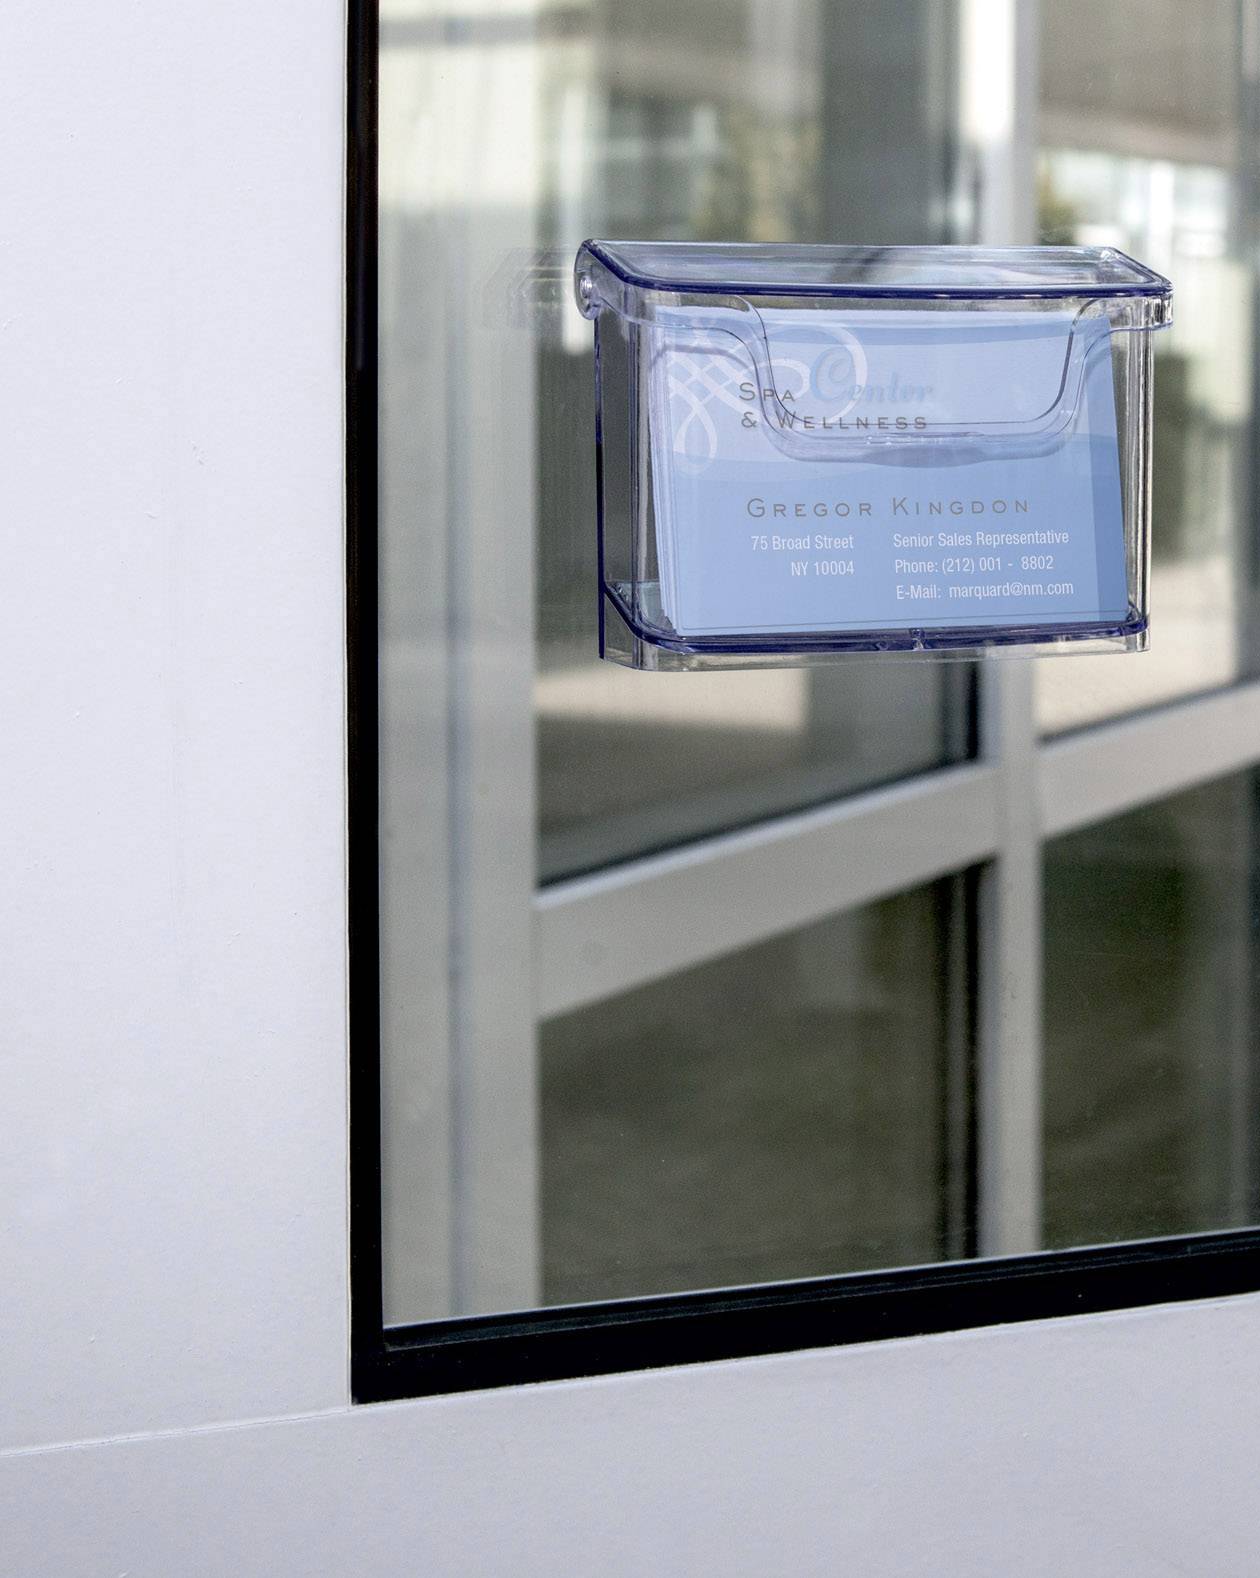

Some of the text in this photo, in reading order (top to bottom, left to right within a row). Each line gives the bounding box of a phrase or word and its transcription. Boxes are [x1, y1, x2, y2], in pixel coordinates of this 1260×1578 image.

[810, 346, 934, 404] Center
[740, 411, 759, 429] &
[751, 534, 855, 551] 75 Broad Street
[893, 529, 1070, 548] Senior Sales Representative
[791, 560, 855, 577] NY 10004
[895, 558, 938, 574] Phone:
[941, 556, 976, 575] (212)
[979, 556, 1002, 572] 001
[1020, 555, 1054, 571] 8802
[896, 581, 1074, 601] E-Mail: marquard@nm.com
